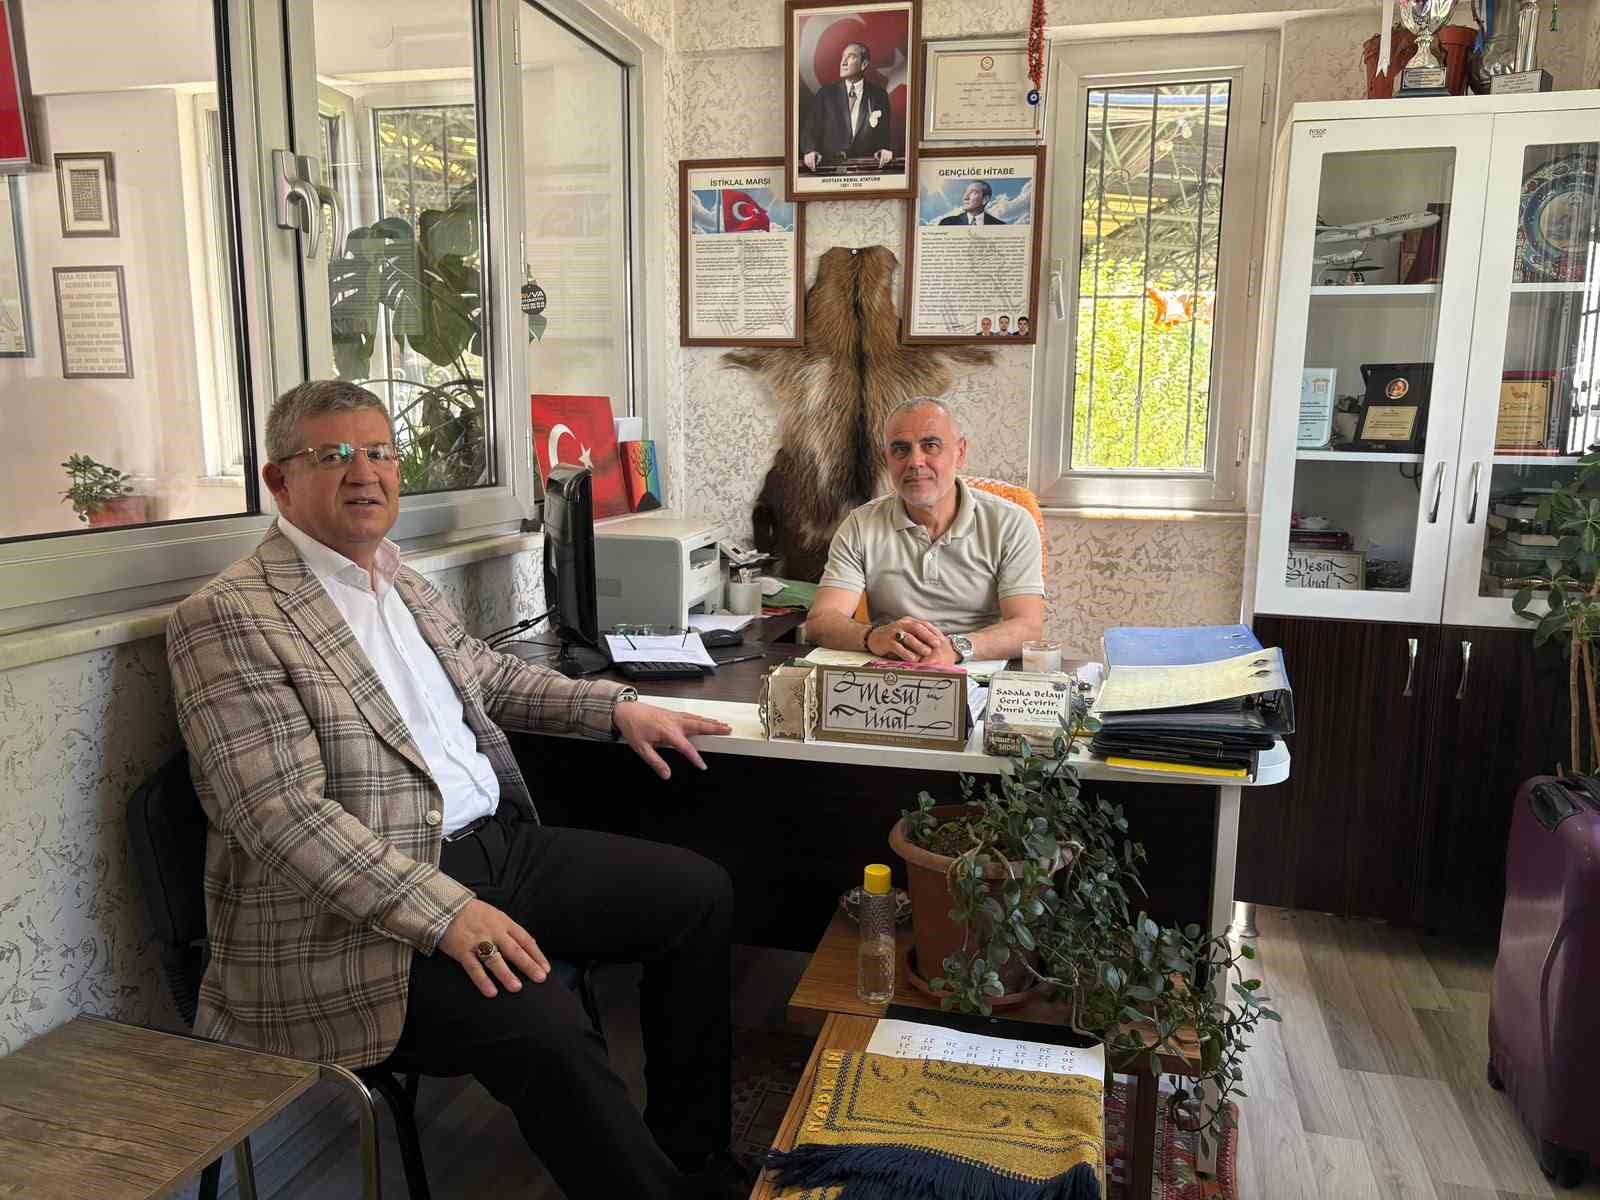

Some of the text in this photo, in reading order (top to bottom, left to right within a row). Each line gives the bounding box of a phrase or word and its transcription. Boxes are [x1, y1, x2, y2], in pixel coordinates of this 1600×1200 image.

[983, 166, 1015, 176] HİTABE
[995, 687, 1031, 698] Sadaka
[999, 697, 1019, 705] Geri
